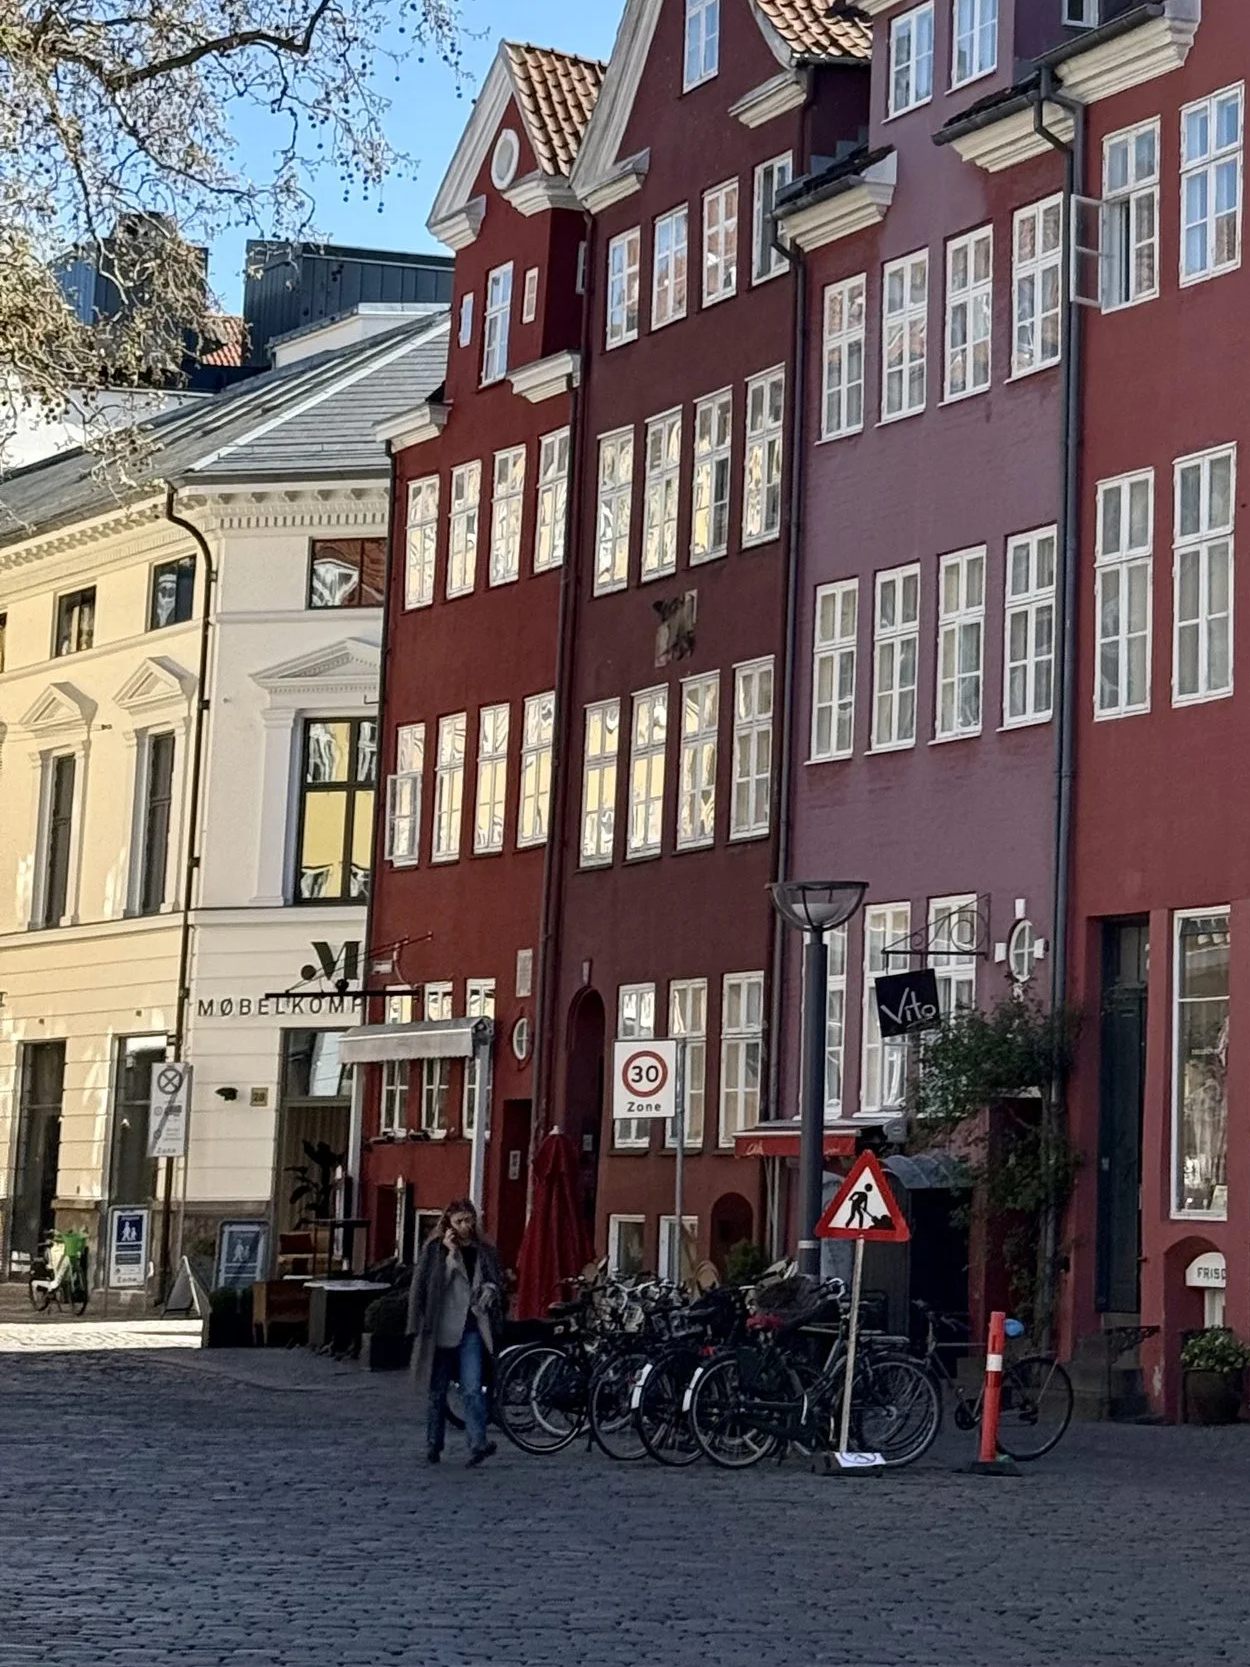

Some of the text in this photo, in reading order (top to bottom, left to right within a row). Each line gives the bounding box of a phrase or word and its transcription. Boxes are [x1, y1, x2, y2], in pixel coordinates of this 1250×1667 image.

[880, 987, 937, 1024] Vito
[631, 1065, 659, 1083] 30
[627, 1101, 662, 1113] Zone
